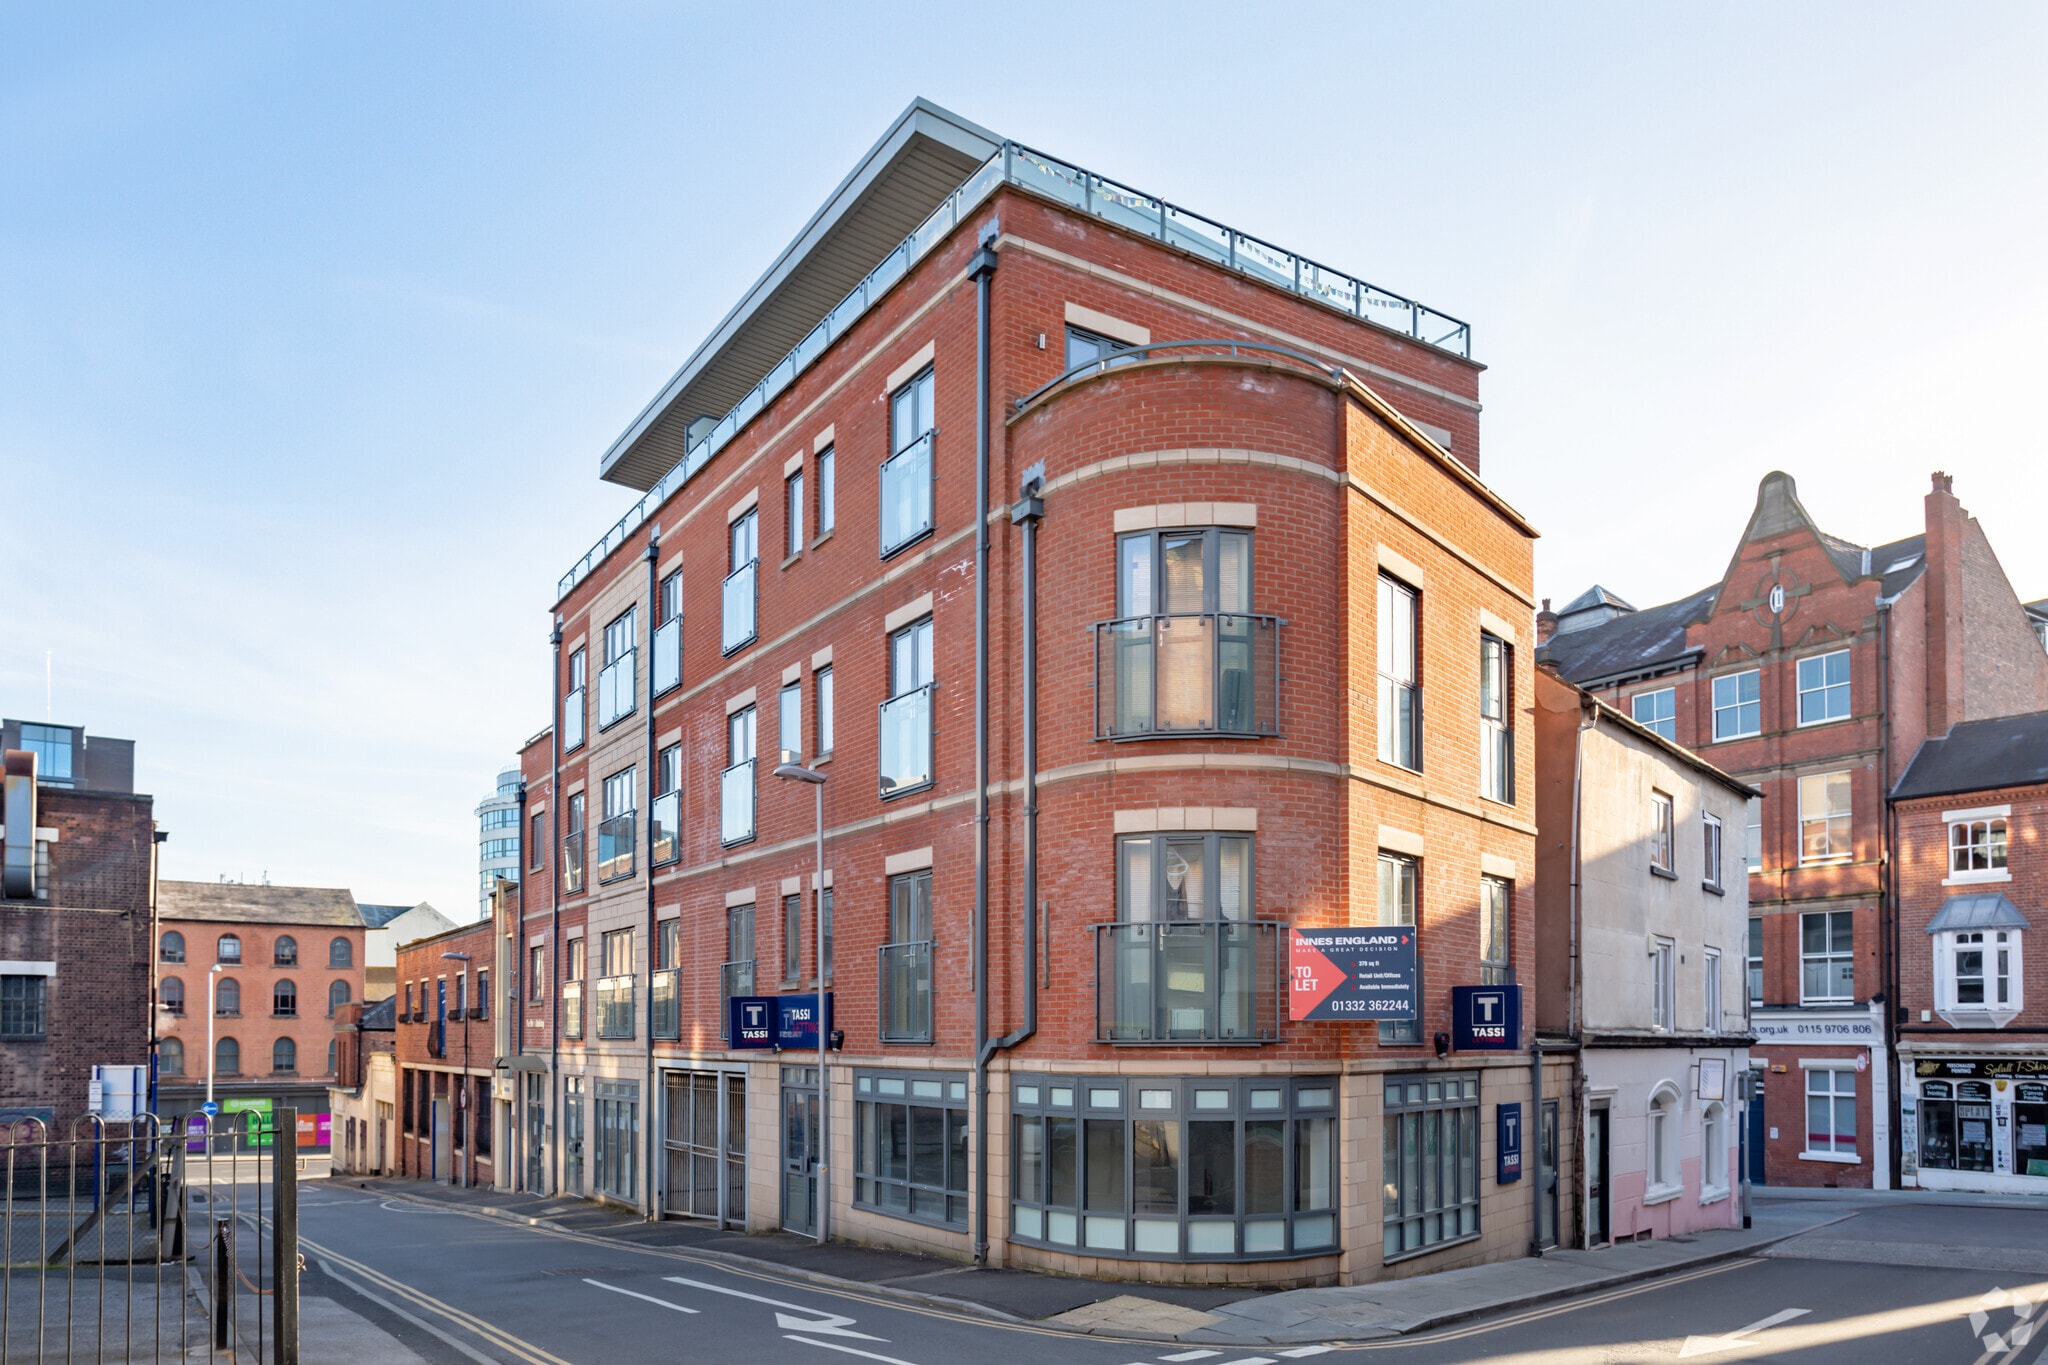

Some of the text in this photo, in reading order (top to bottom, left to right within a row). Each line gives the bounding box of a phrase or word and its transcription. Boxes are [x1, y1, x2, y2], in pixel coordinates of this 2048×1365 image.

[1296, 935, 1398, 946] INNES ENGLAND
[1295, 966, 1312, 978] TO
[1295, 979, 1319, 991] LET
[1332, 999, 1409, 1012] 01332 362244
[1477, 996, 1499, 1022] T
[746, 1006, 763, 1026] T
[792, 1008, 811, 1020] TASSI
[791, 1021, 820, 1034] LETTING
[1471, 1027, 1505, 1037] TASSI
[1797, 1024, 1822, 1034] 0115
[1824, 1024, 1850, 1034] 9706
[1852, 1024, 1872, 1034] 806
[741, 1030, 769, 1039] TASSI
[1506, 1118, 1516, 1147] T
[1503, 1154, 1519, 1166] TASSI
